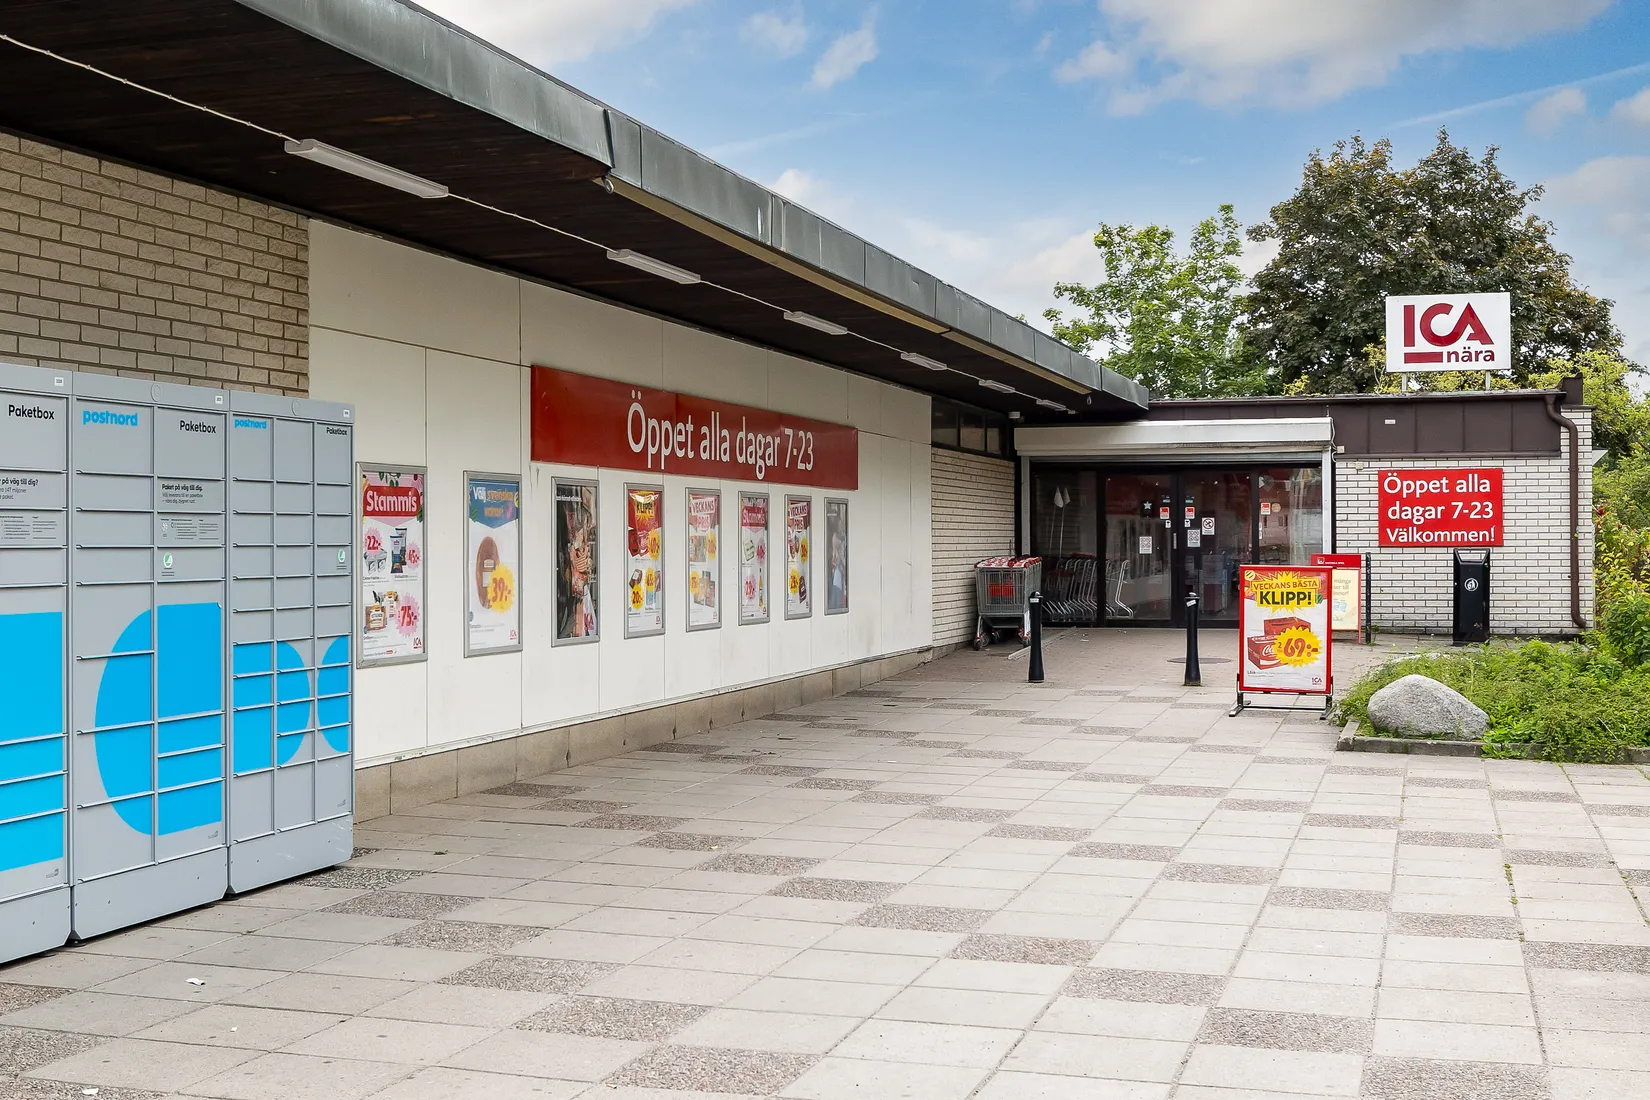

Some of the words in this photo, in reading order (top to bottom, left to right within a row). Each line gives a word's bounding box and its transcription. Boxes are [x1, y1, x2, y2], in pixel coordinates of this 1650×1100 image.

[1403, 301, 1495, 347] ICA
[1446, 346, 1495, 364] nära
[8, 404, 55, 420] Paketbox
[82, 410, 138, 427] postnord
[179, 420, 216, 434] Paketbox
[234, 419, 267, 430] postnord
[326, 427, 347, 436] Paketbox
[627, 389, 694, 469] Öppet
[700, 410, 730, 462] alla
[736, 415, 780, 480] dagar
[784, 427, 814, 471] 7-23
[2, 477, 9, 485] på
[10, 478, 20, 486] väg
[28, 479, 39, 487] dig?
[174, 484, 180, 492] på
[181, 484, 189, 492] väg
[1383, 472, 1449, 498] Öppet
[1455, 473, 1490, 493] alla
[366, 490, 417, 512] Stammis
[473, 485, 486, 504] Välj
[691, 499, 715, 514] VECKANS
[790, 503, 807, 518] VECKANS
[1388, 500, 1445, 525] dagar
[1451, 501, 1494, 519] 7-23
[794, 518, 804, 530] PRIS
[1386, 524, 1495, 543] Välkommen!
[492, 577, 511, 603] 39:-
[1253, 581, 1291, 590] VECKANS
[1292, 579, 1318, 589] BÄSTA
[1259, 591, 1312, 606] KLIPP!
[413, 637, 422, 646] ICA
[1283, 637, 1319, 658] 69:-
